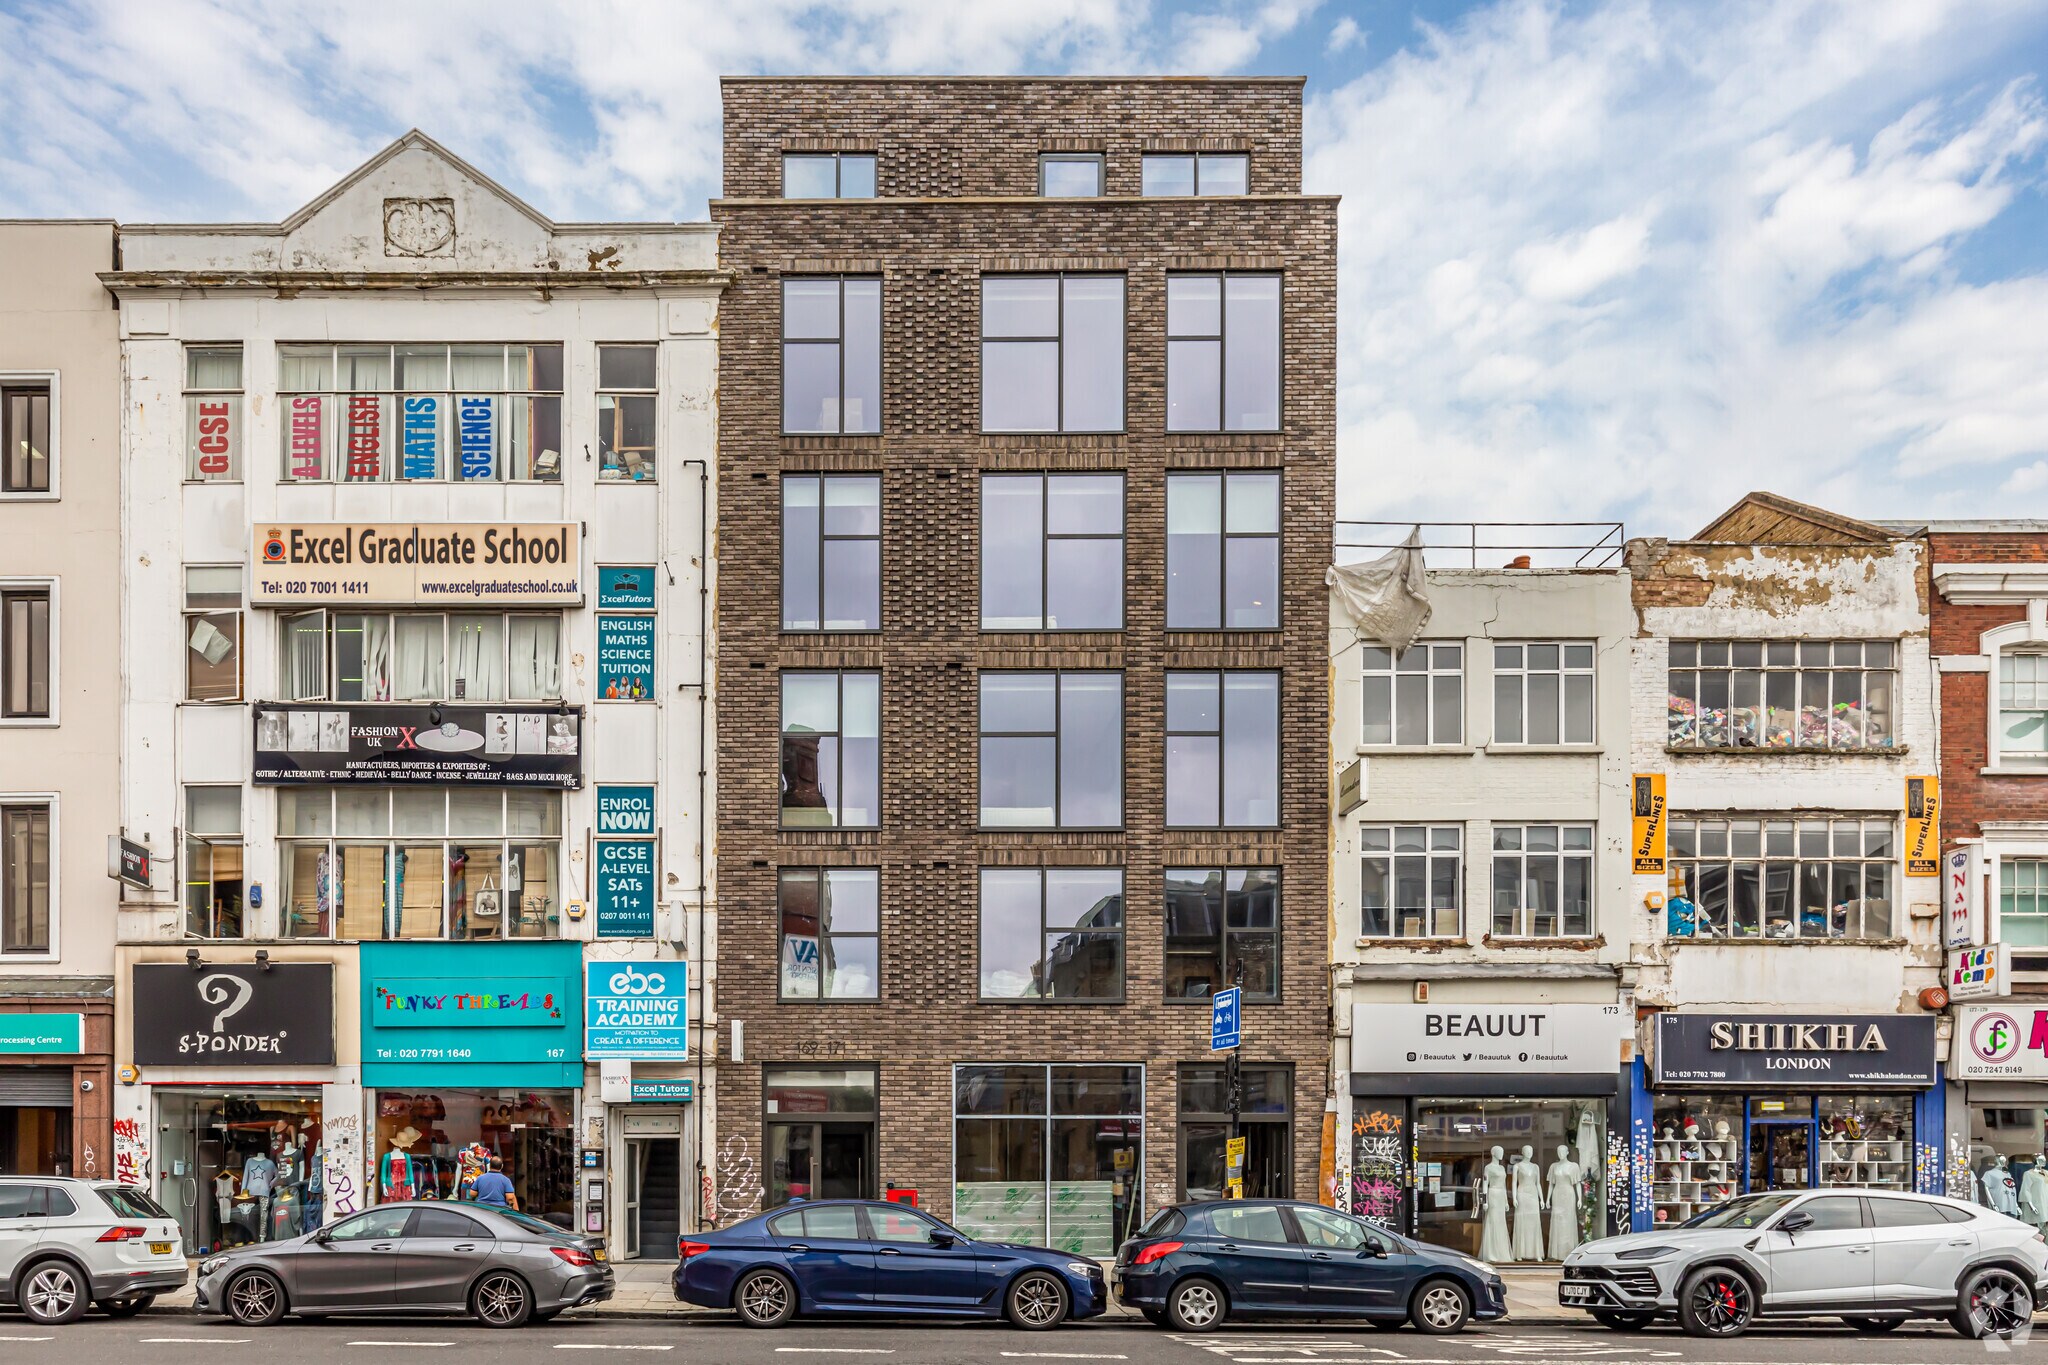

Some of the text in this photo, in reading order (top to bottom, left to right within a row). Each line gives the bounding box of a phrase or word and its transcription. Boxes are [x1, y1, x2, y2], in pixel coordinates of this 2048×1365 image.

[199, 402, 229, 474] GCSE
[292, 397, 322, 478] A-LEVELS
[348, 397, 380, 477] ENGLISH
[404, 397, 437, 479] MATHS
[461, 398, 492, 479] SCIENCE
[290, 527, 567, 564] Excel Graduate School
[261, 581, 369, 594] Tel: 020 7001 1411
[422, 579, 578, 597] www.excelgraduateschool.co.uk
[601, 620, 652, 631] ENGLISH
[605, 635, 648, 645] MATHS
[601, 649, 652, 660] SCIENCE
[601, 663, 651, 674] TUITION
[350, 726, 418, 750] FASHION X
[367, 737, 383, 748] UK
[346, 761, 400, 769] MANUFACTURERS,
[401, 762, 435, 770] IMPORTERS
[442, 762, 478, 771] EXPORTERS
[255, 770, 278, 778] GOTHIC
[284, 769, 325, 778] ALTERNATIVE
[330, 770, 352, 778] ETHNIC
[355, 770, 387, 779] MEDIEVAL
[391, 770, 411, 779] BELLY
[411, 771, 431, 779] DANCE
[436, 771, 461, 779] INCENSE
[465, 772, 502, 780] JEWELLERY
[525, 773, 537, 781] AND
[538, 773, 555, 781] MUCH
[600, 798, 650, 810] ENROL
[600, 811, 650, 830] NOW
[603, 846, 647, 860] GCSE
[600, 864, 650, 874] A-LEVEL
[608, 878, 643, 891] SATs
[611, 896, 640, 908] 11+
[600, 912, 650, 920] 0207 0011 411
[1956, 926, 1964, 934] of
[1960, 948, 1995, 971] Kids
[609, 965, 666, 995] ebc
[1953, 966, 1996, 985] Kemp
[385, 992, 554, 1012] FUNKY THREADS
[596, 999, 679, 1012] TRAINING
[1602, 1006, 1619, 1014] 173
[596, 1013, 678, 1026] ACADEMY
[1425, 1014, 1546, 1037] BEAUUT
[36, 1036, 63, 1044] Centre
[593, 1037, 680, 1045] CREATE A DIFFERENCE
[1710, 1021, 1888, 1051] SHIKHA
[399, 1049, 418, 1058] 020
[420, 1049, 443, 1058] 7791
[447, 1049, 471, 1058] 1640
[546, 1049, 564, 1058] 167
[1424, 1053, 1456, 1061] Beauutuk
[1479, 1053, 1511, 1061] Beauutuk
[1536, 1053, 1568, 1061] Beauutuk
[1766, 1058, 1831, 1070] LONDON
[1968, 1066, 2023, 1074] 020 7247 9149
[621, 1075, 629, 1085] X
[1665, 1070, 1677, 1078] Tel:
[1710, 1071, 1726, 1079] 7800
[1848, 1072, 1928, 1080] www.shikhalondon.com
[633, 1085, 689, 1093] Excel Tutors
